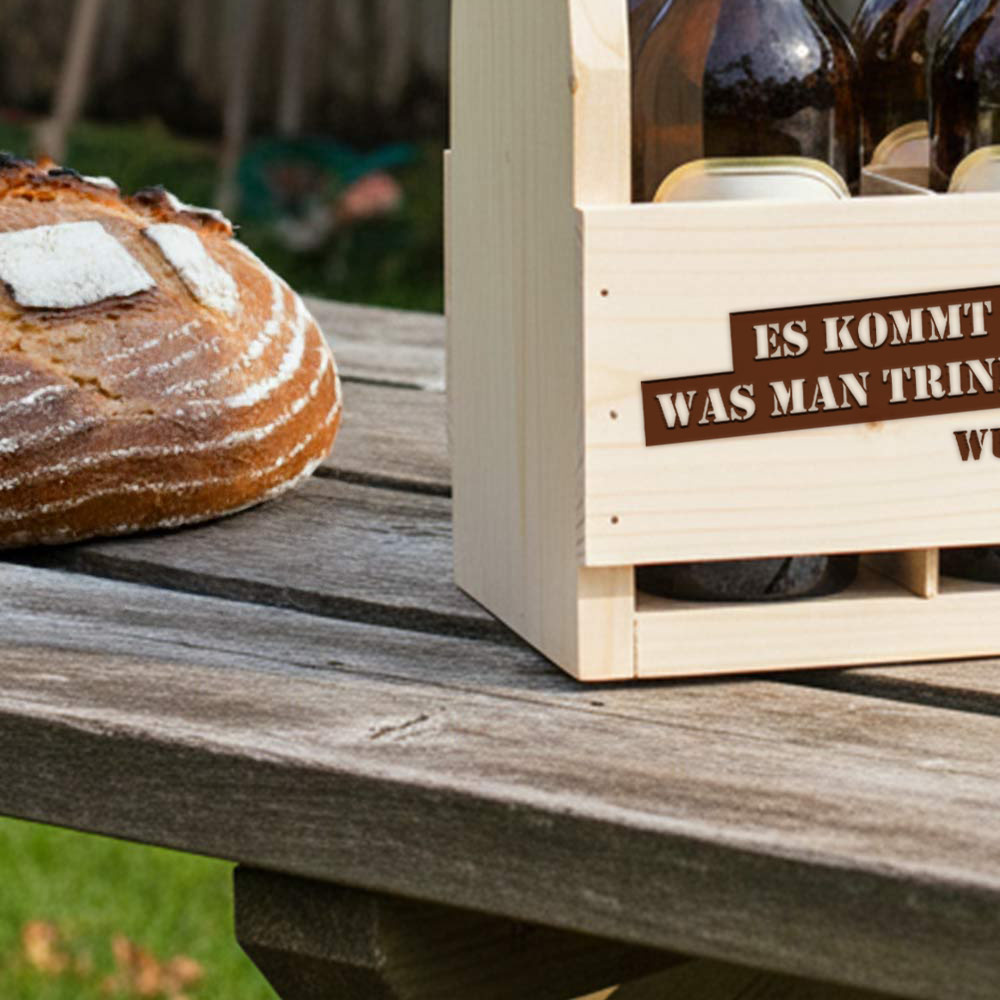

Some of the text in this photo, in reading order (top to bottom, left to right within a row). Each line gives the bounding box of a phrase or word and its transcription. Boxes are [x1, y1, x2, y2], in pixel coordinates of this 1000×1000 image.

[753, 319, 809, 361] ES
[822, 301, 993, 354] KOMMT
[655, 383, 756, 430] WAS
[769, 371, 871, 418] MAN
